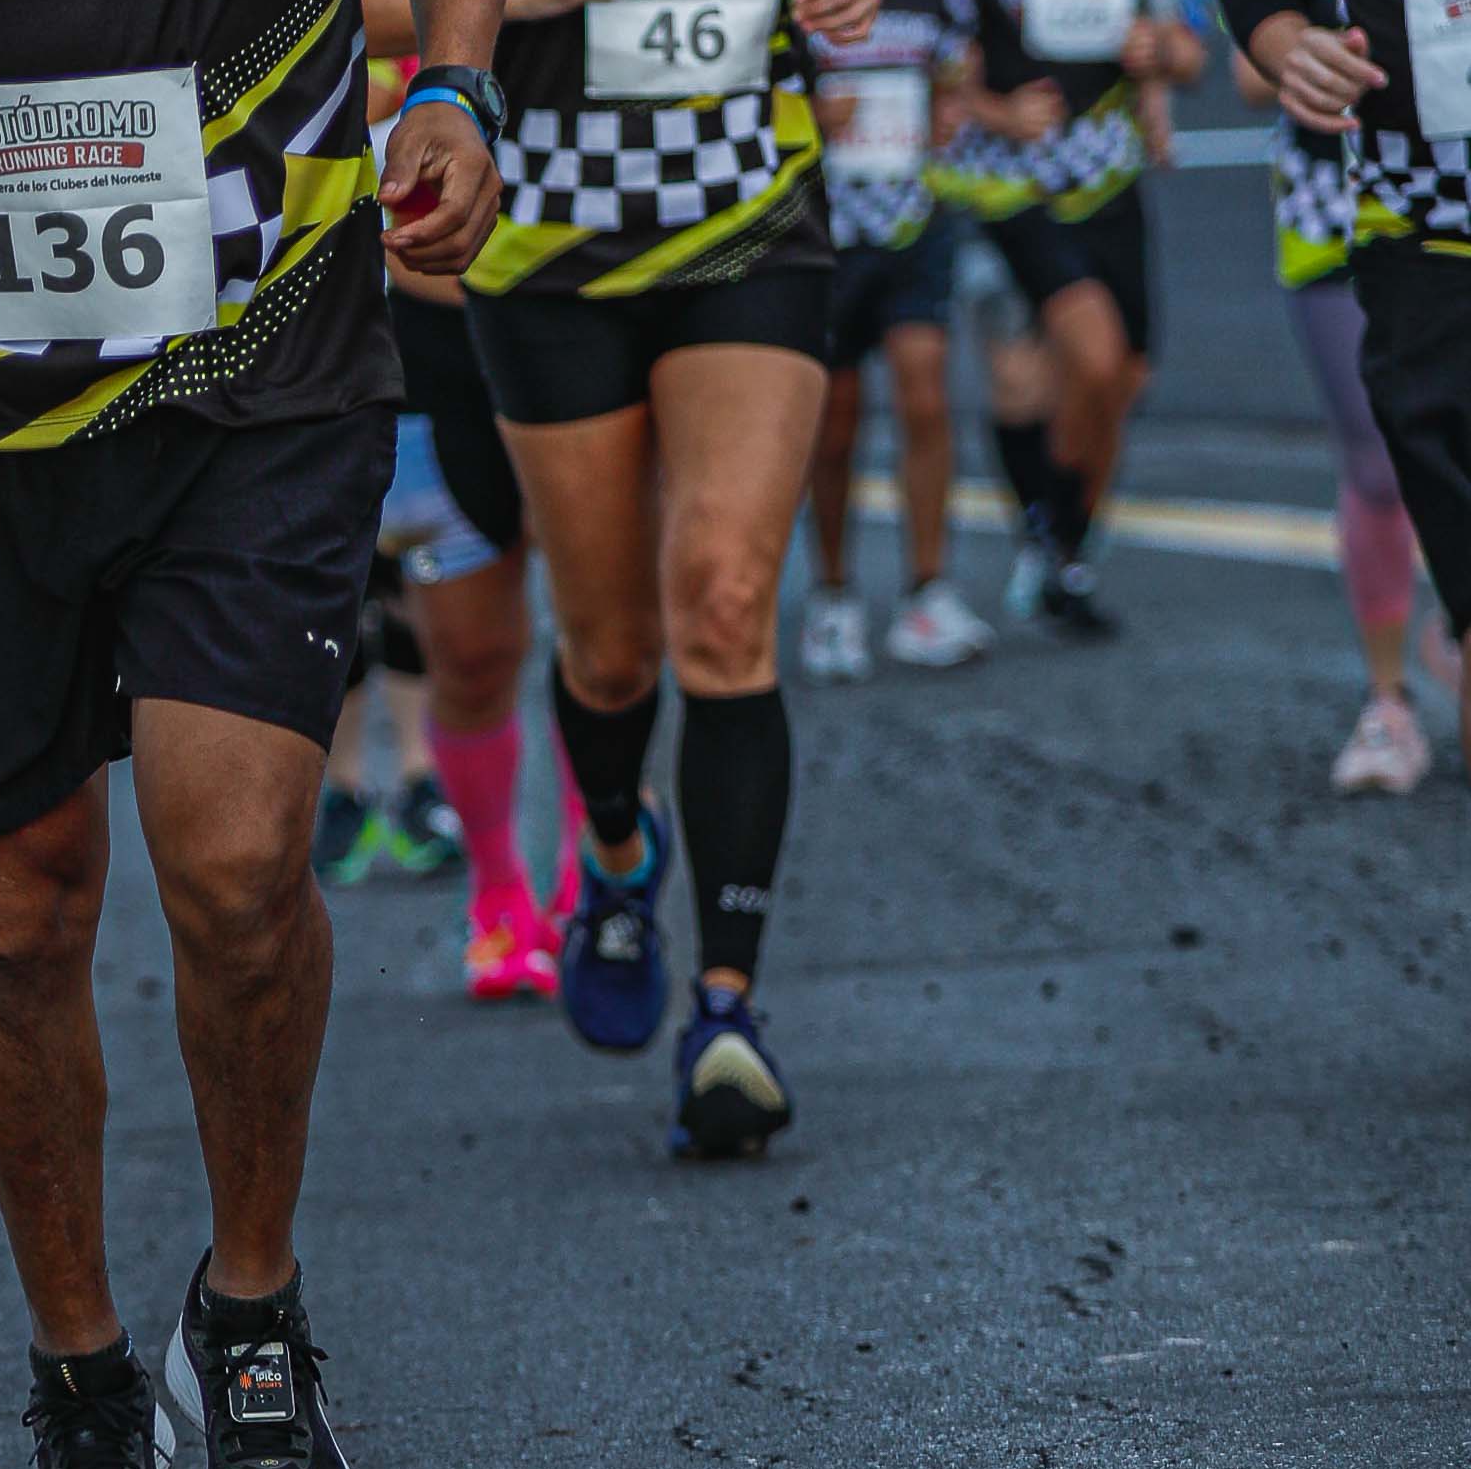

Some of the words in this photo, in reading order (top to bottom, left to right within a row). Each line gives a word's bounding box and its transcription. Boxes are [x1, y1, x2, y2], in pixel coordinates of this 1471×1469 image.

[640, 5, 727, 66] 46
[75, 143, 123, 166] RACE
[16, 180, 30, 193] de
[32, 181, 48, 192] los
[49, 178, 88, 191] Clubes
[90, 175, 109, 187] del
[111, 171, 162, 184] Noroeste
[255, 1372, 282, 1382] IPICO
